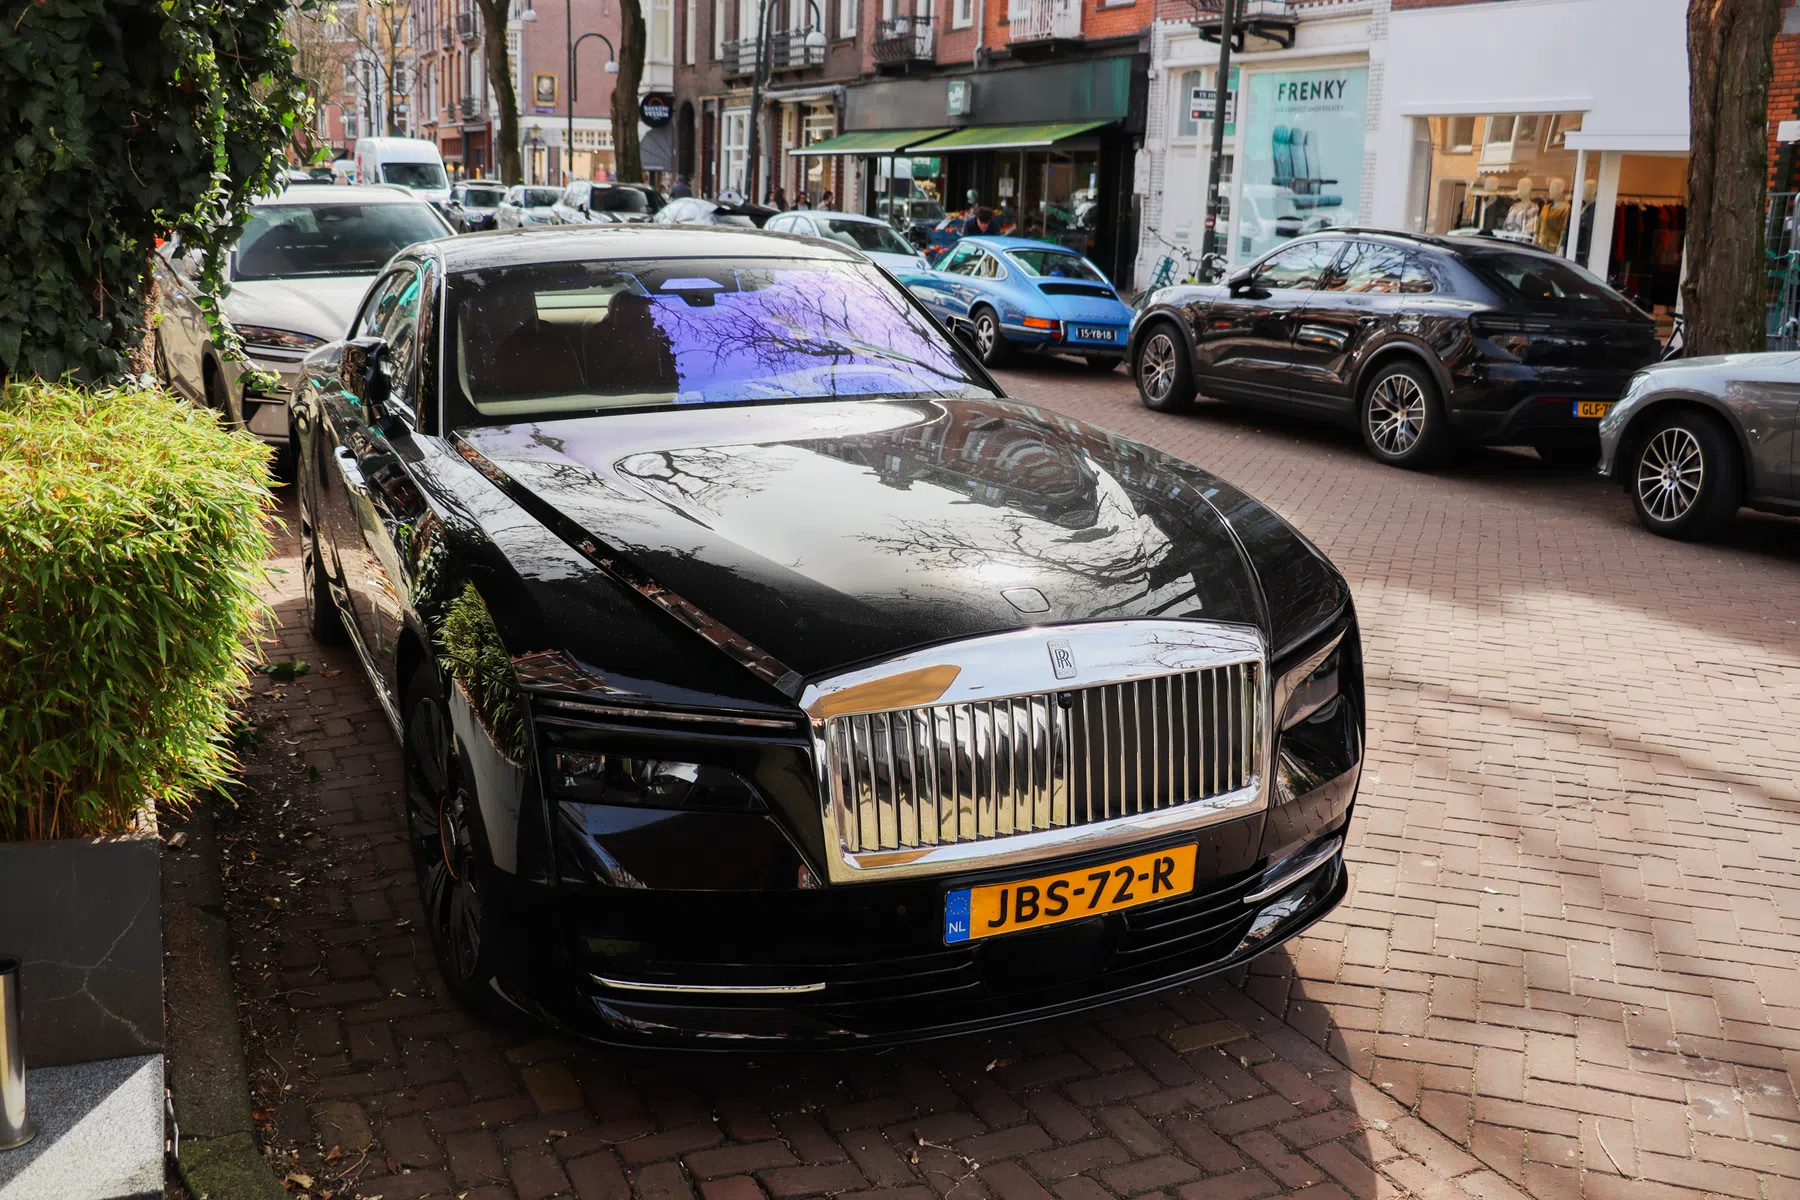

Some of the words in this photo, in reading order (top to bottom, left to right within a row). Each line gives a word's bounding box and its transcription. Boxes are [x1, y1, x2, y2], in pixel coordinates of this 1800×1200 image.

[1278, 79, 1347, 101] FRENKY
[1081, 329, 1112, 340] 15-YB-18
[948, 922, 967, 934] NL
[988, 856, 1176, 929] JBS-72-R
